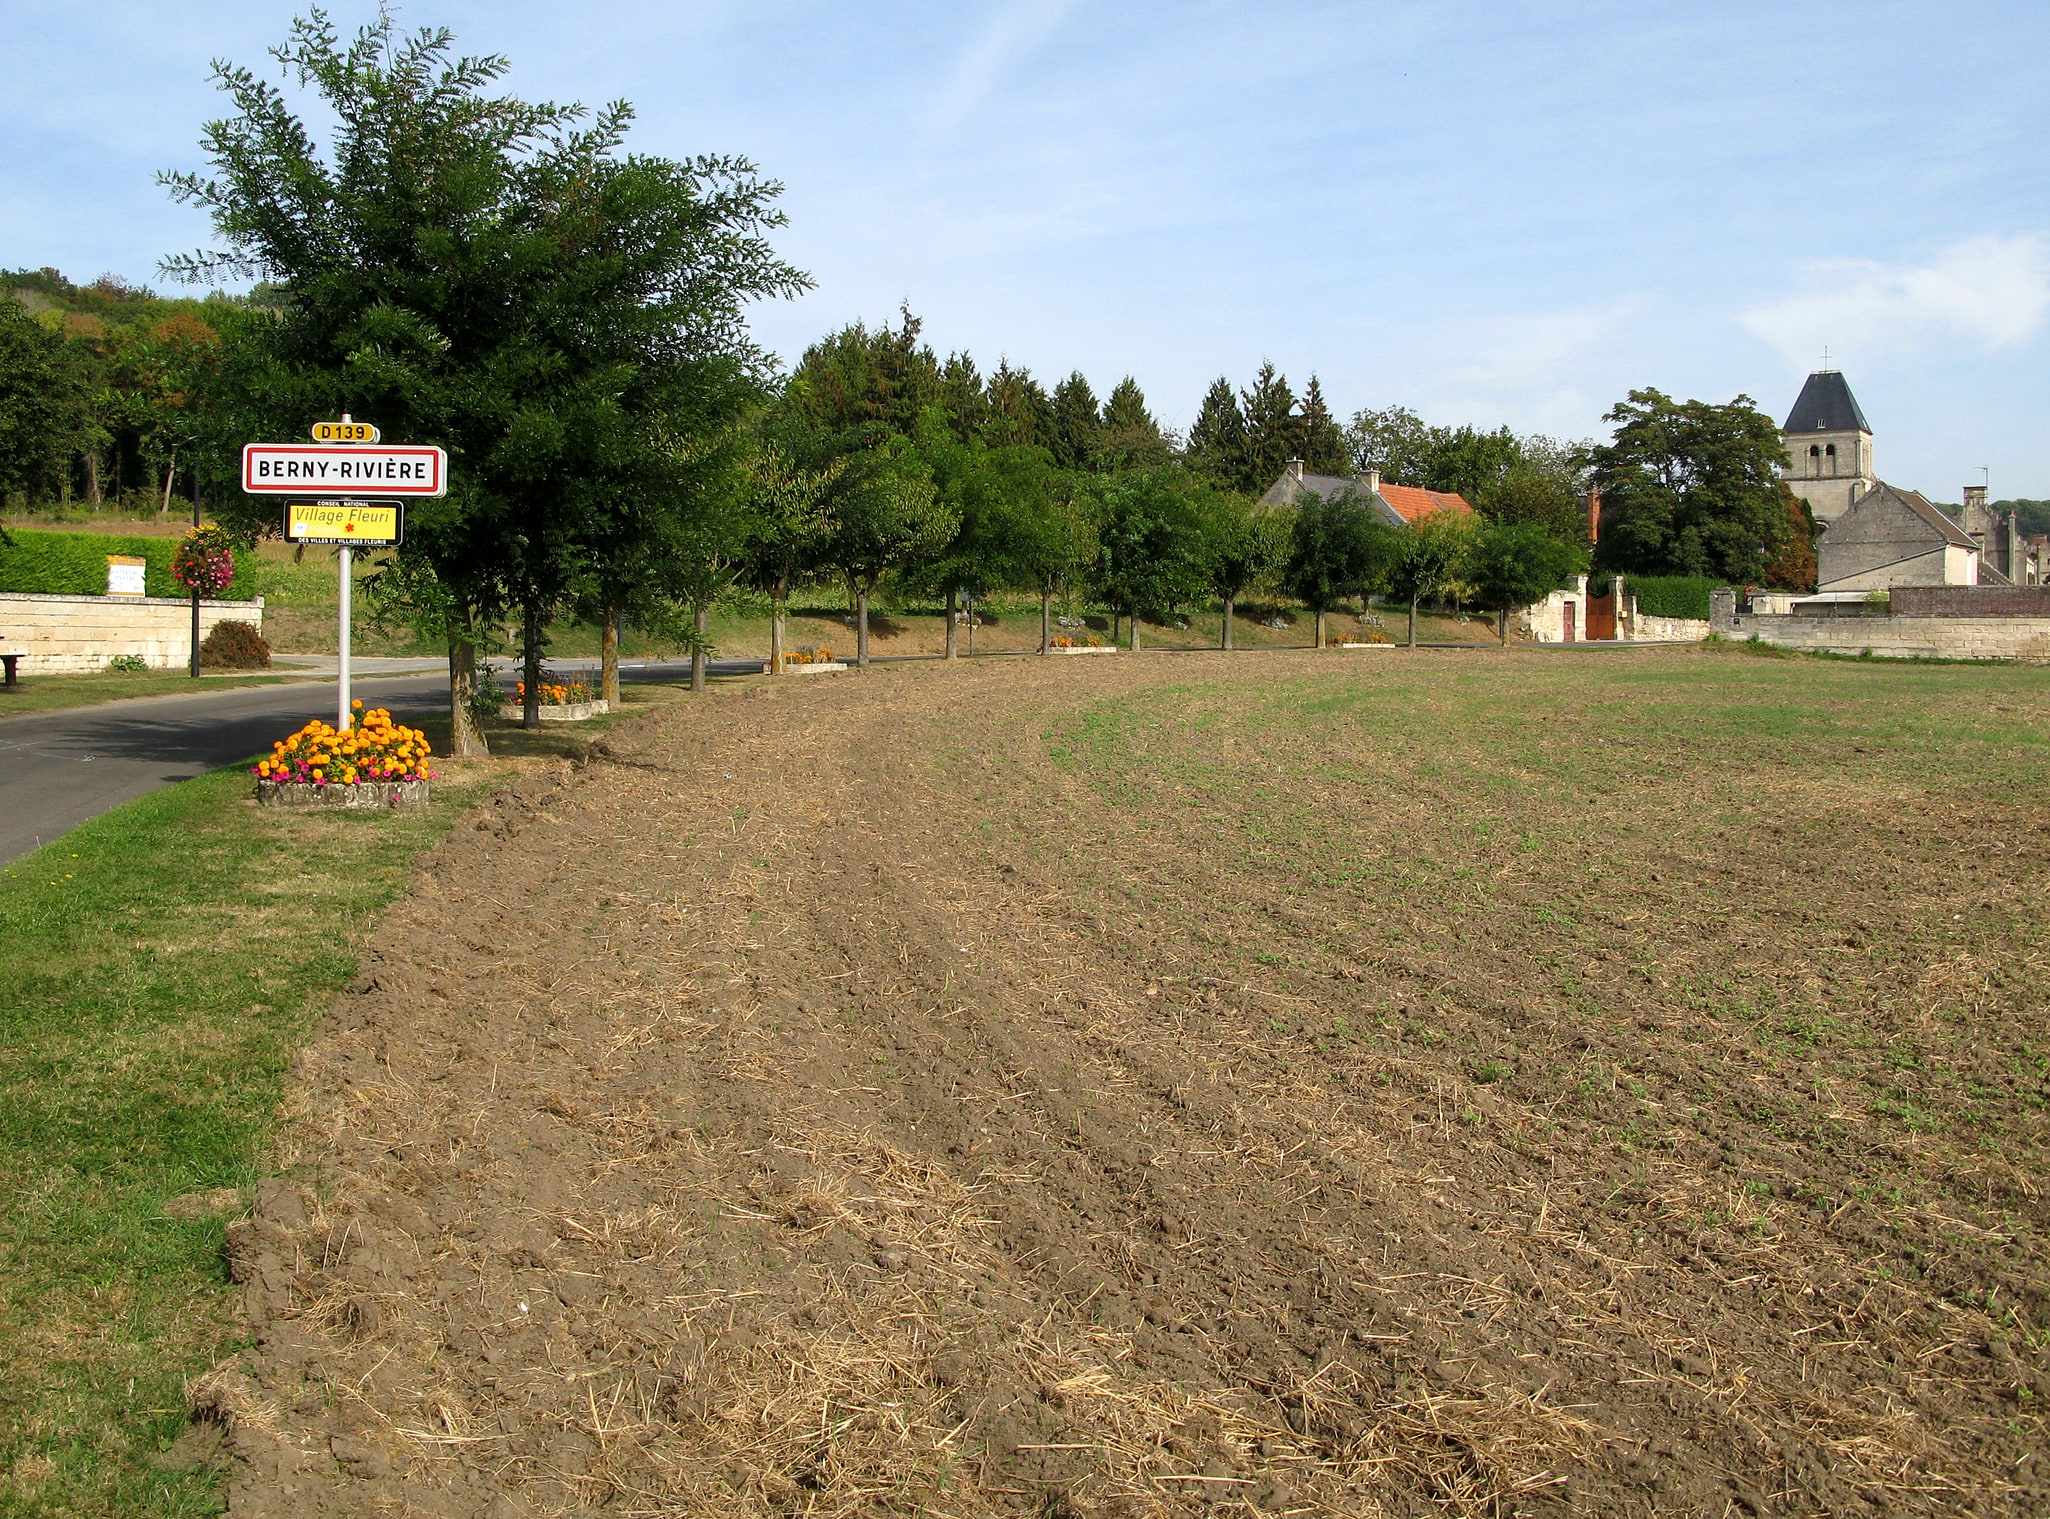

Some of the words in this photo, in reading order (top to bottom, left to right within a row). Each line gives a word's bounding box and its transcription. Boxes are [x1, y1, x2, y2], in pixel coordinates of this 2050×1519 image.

[259, 458, 426, 479] BERNY-RIVIÈRE
[296, 507, 343, 525] Village
[349, 508, 390, 523] Fleuri
